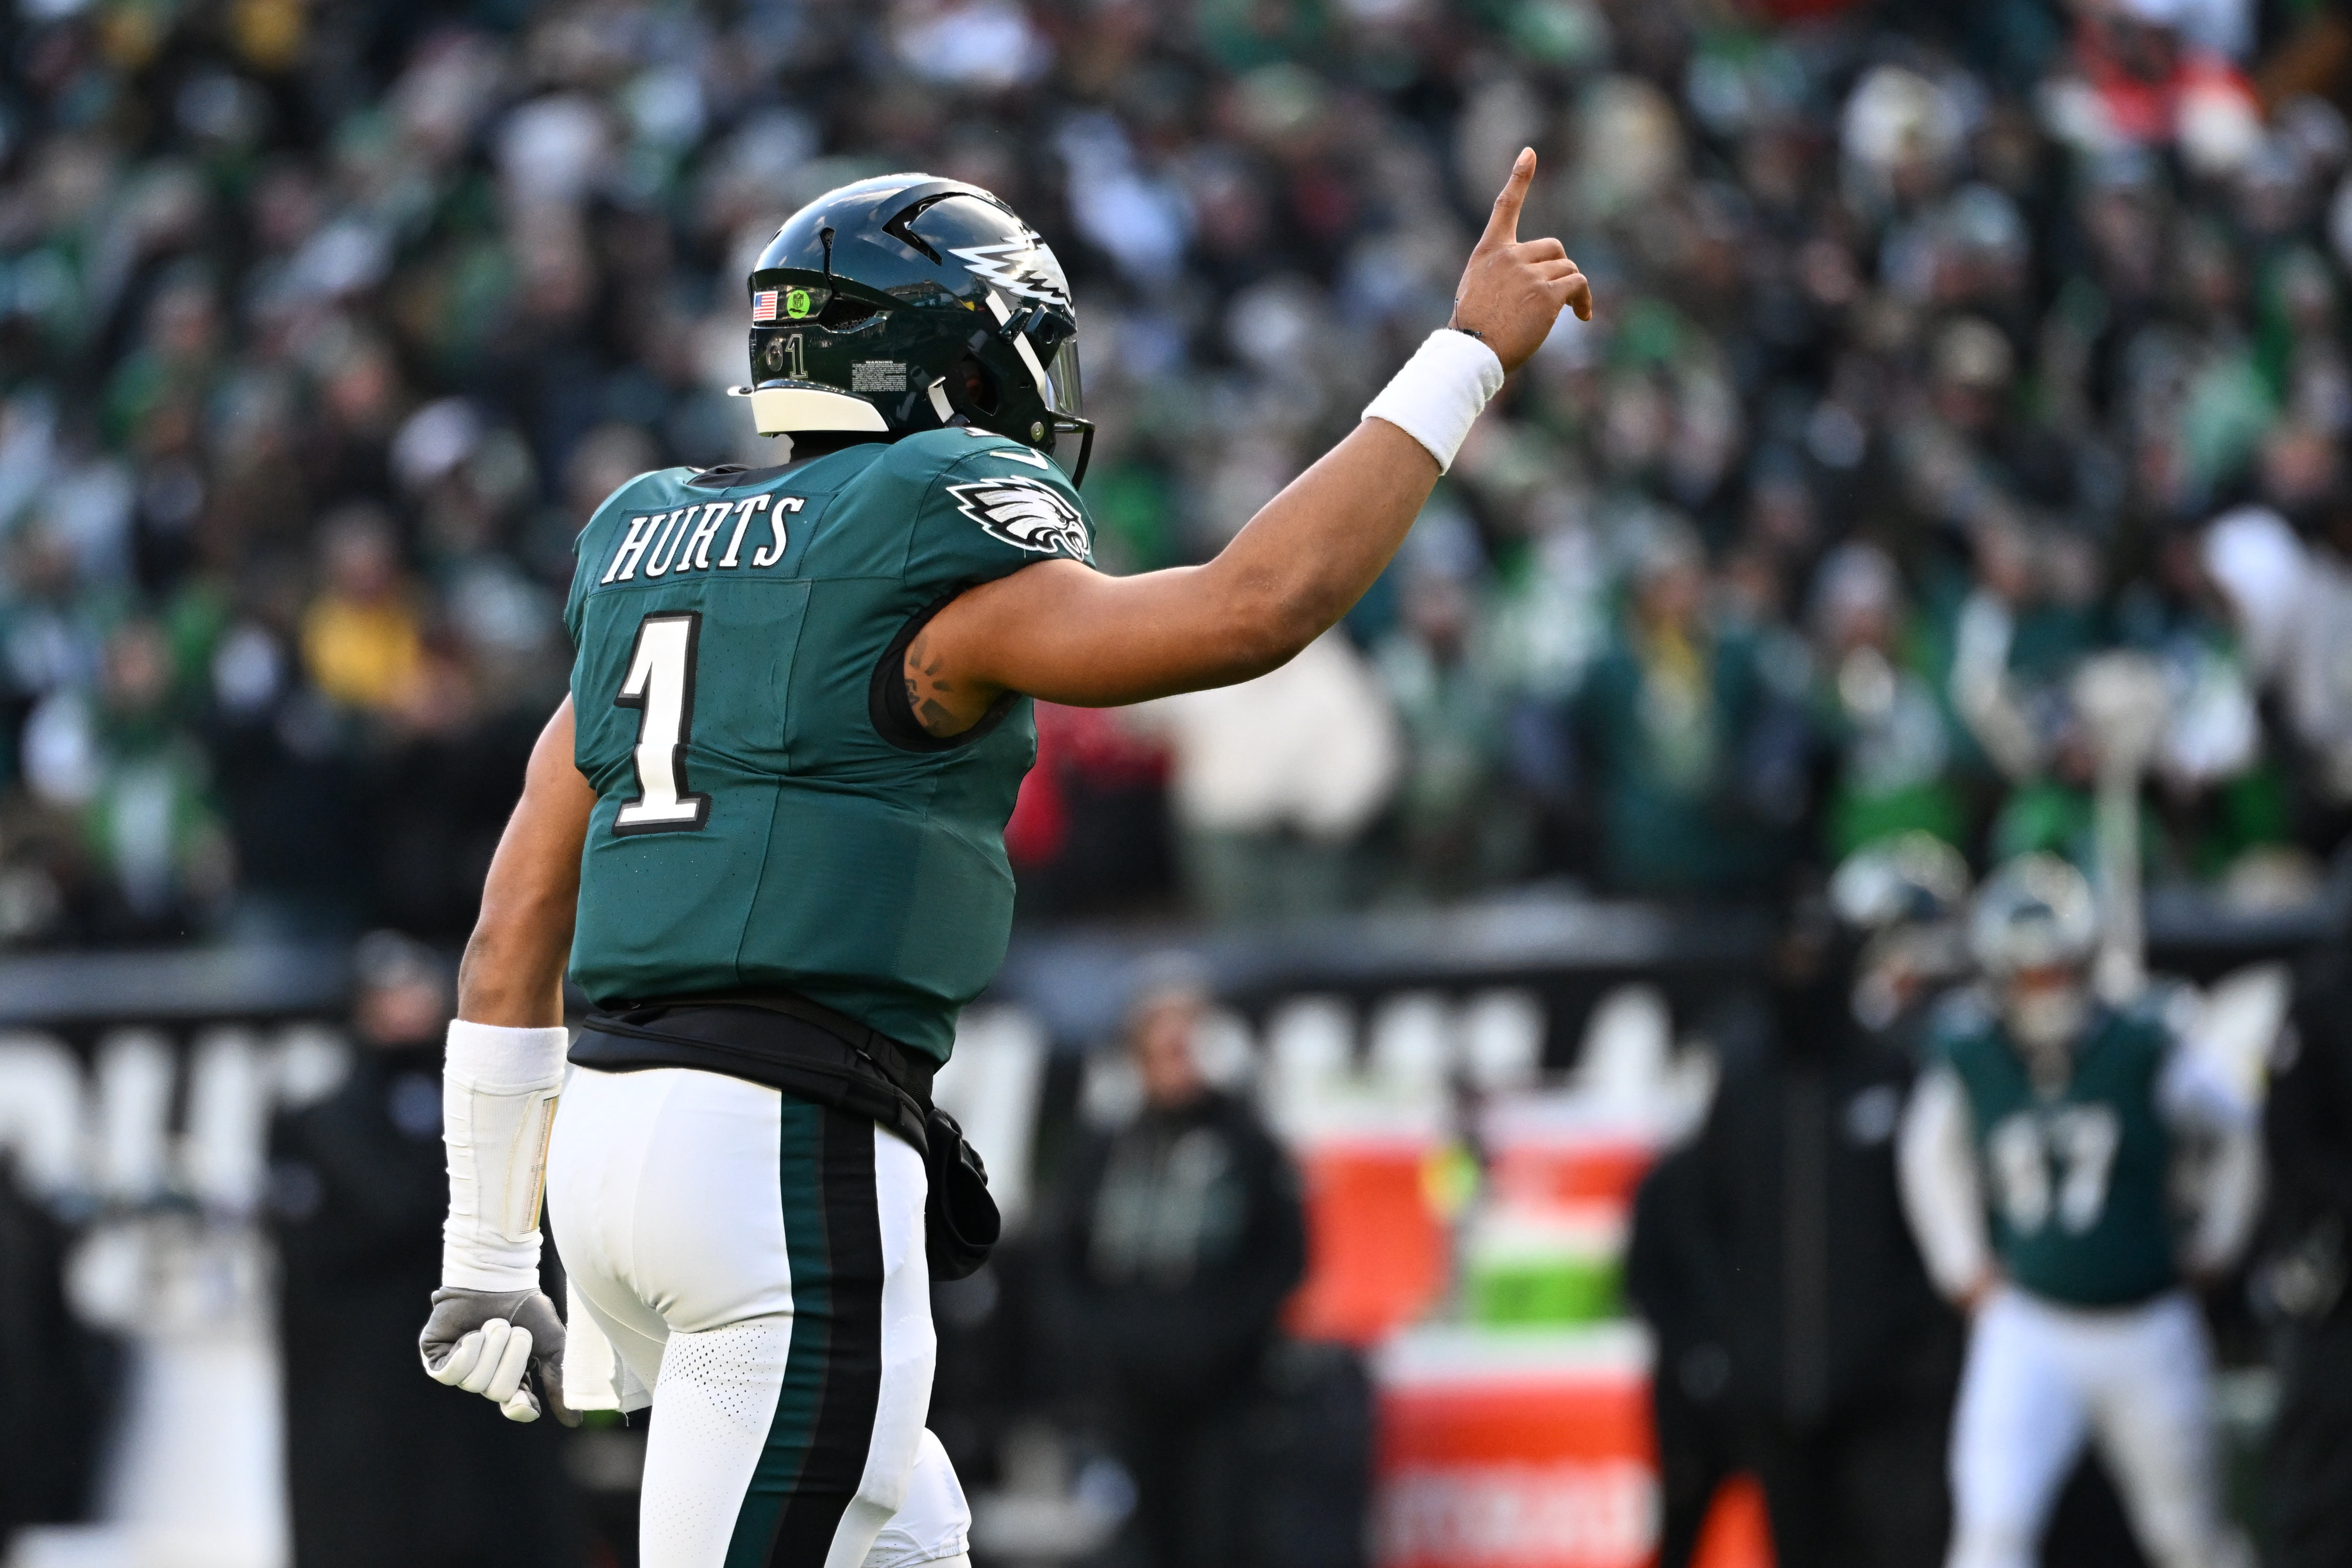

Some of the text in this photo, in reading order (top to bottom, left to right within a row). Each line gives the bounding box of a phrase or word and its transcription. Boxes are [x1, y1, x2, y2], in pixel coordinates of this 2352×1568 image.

[794, 299, 803, 307] NFL
[785, 334, 808, 379] 1
[600, 493, 807, 586] HURTS
[614, 612, 711, 835] 1
